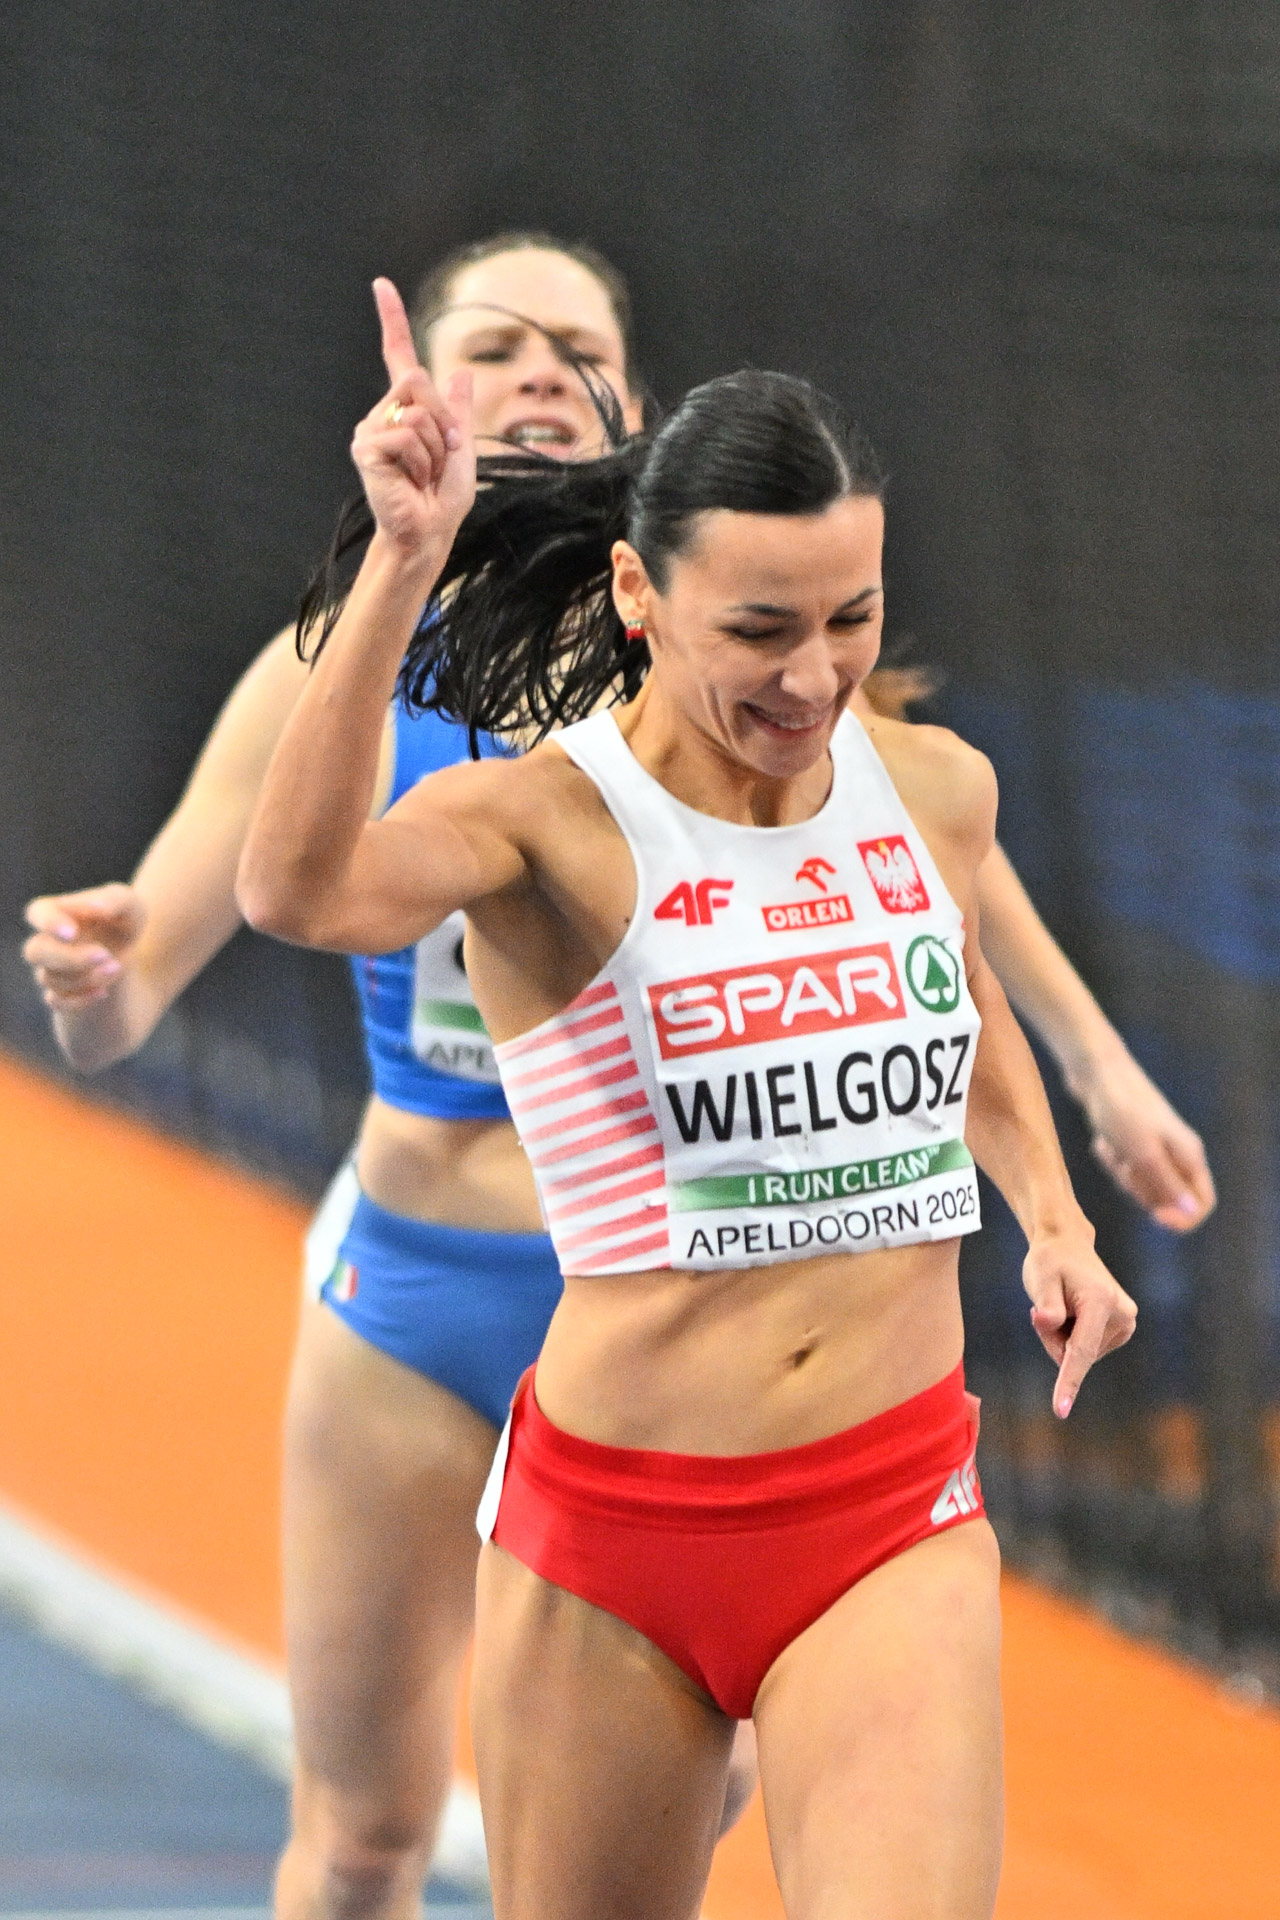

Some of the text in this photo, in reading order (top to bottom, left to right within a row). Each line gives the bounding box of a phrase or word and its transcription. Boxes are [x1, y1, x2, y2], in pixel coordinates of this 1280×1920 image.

[654, 878, 734, 926] 4F
[767, 900, 848, 929] ORLEN
[659, 955, 898, 1046] SPAR
[665, 1034, 970, 1143] WIELGOSZ
[748, 1179, 757, 1203] I
[764, 1170, 834, 1202] RUN
[686, 1185, 976, 1258] APELDOORN 2025
